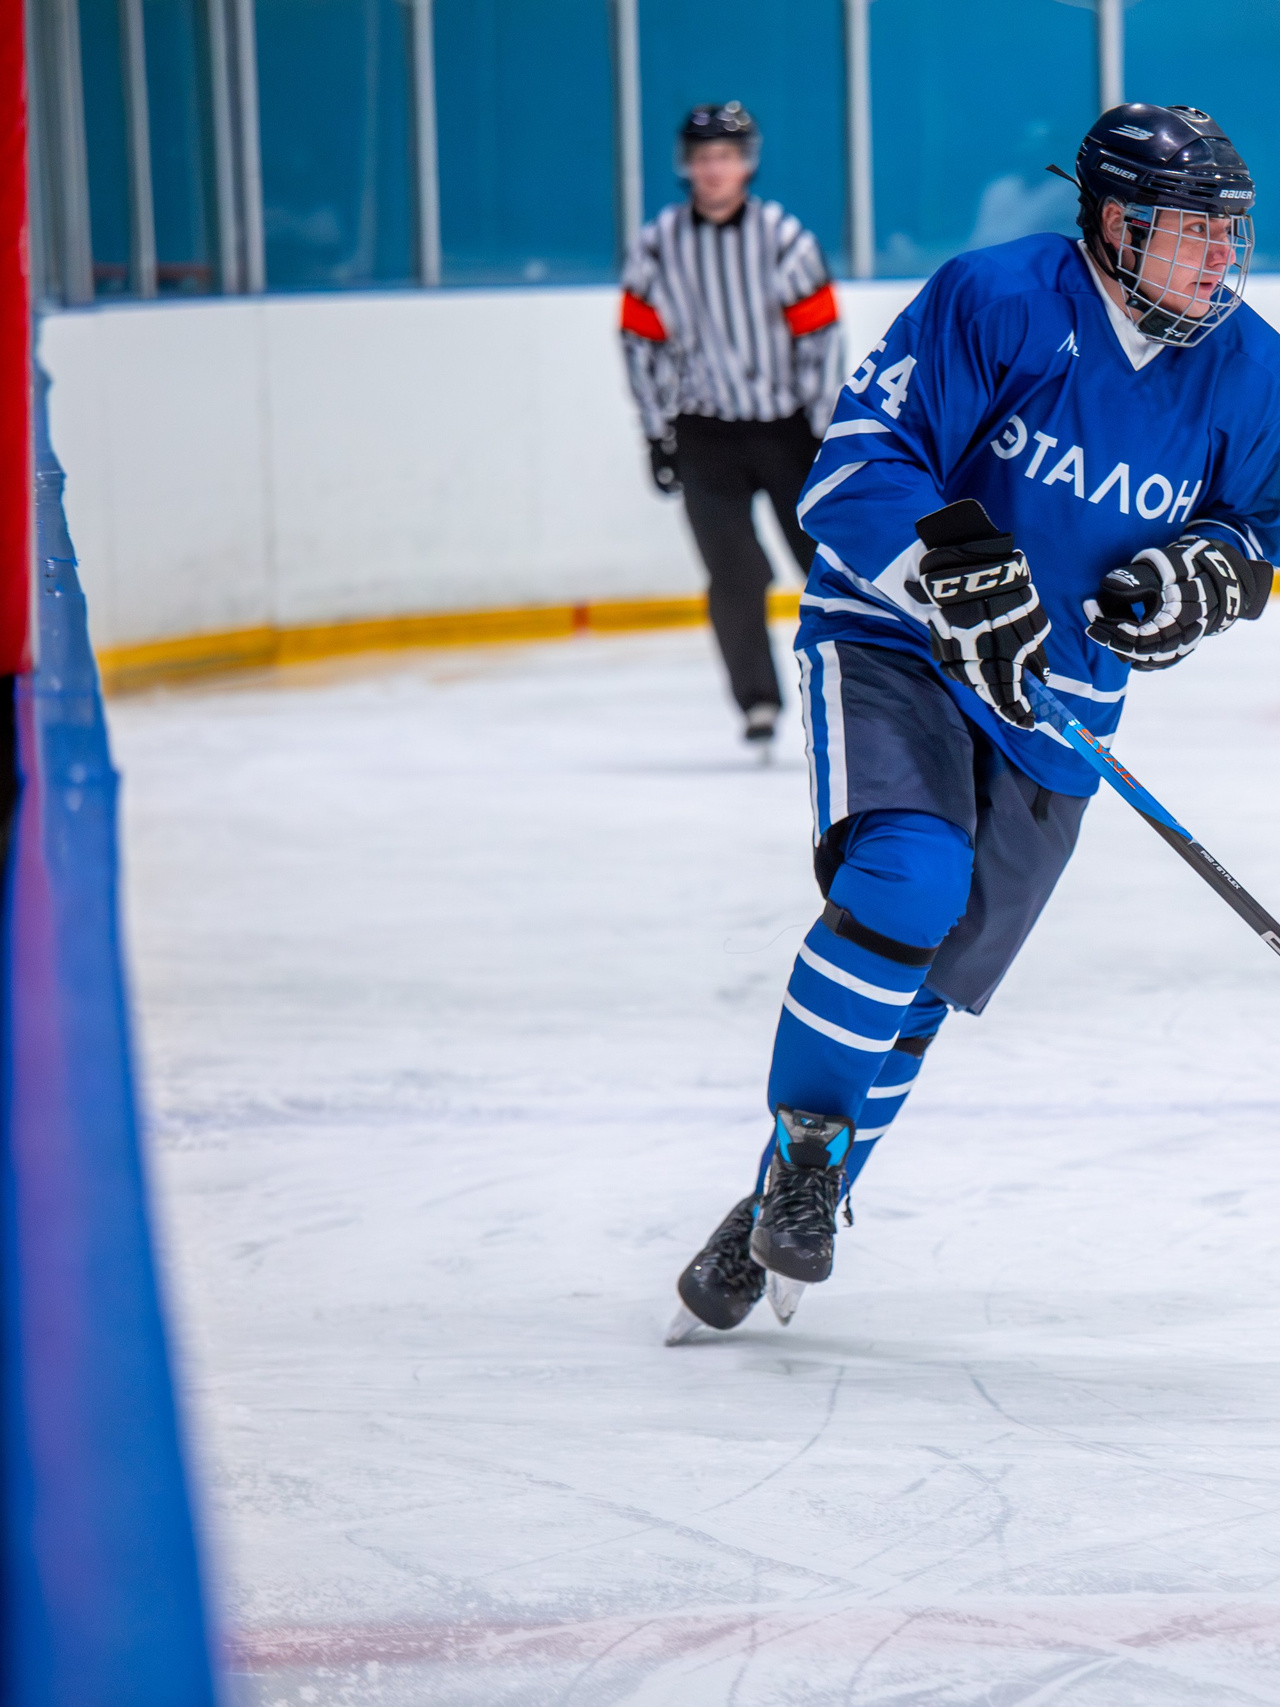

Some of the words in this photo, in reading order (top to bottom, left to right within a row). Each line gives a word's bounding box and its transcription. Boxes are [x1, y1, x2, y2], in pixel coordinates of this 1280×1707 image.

[990, 414, 1203, 524] ЭТАЛОН
[931, 556, 1028, 599] CCM
[1076, 731, 1142, 789] SYNC
